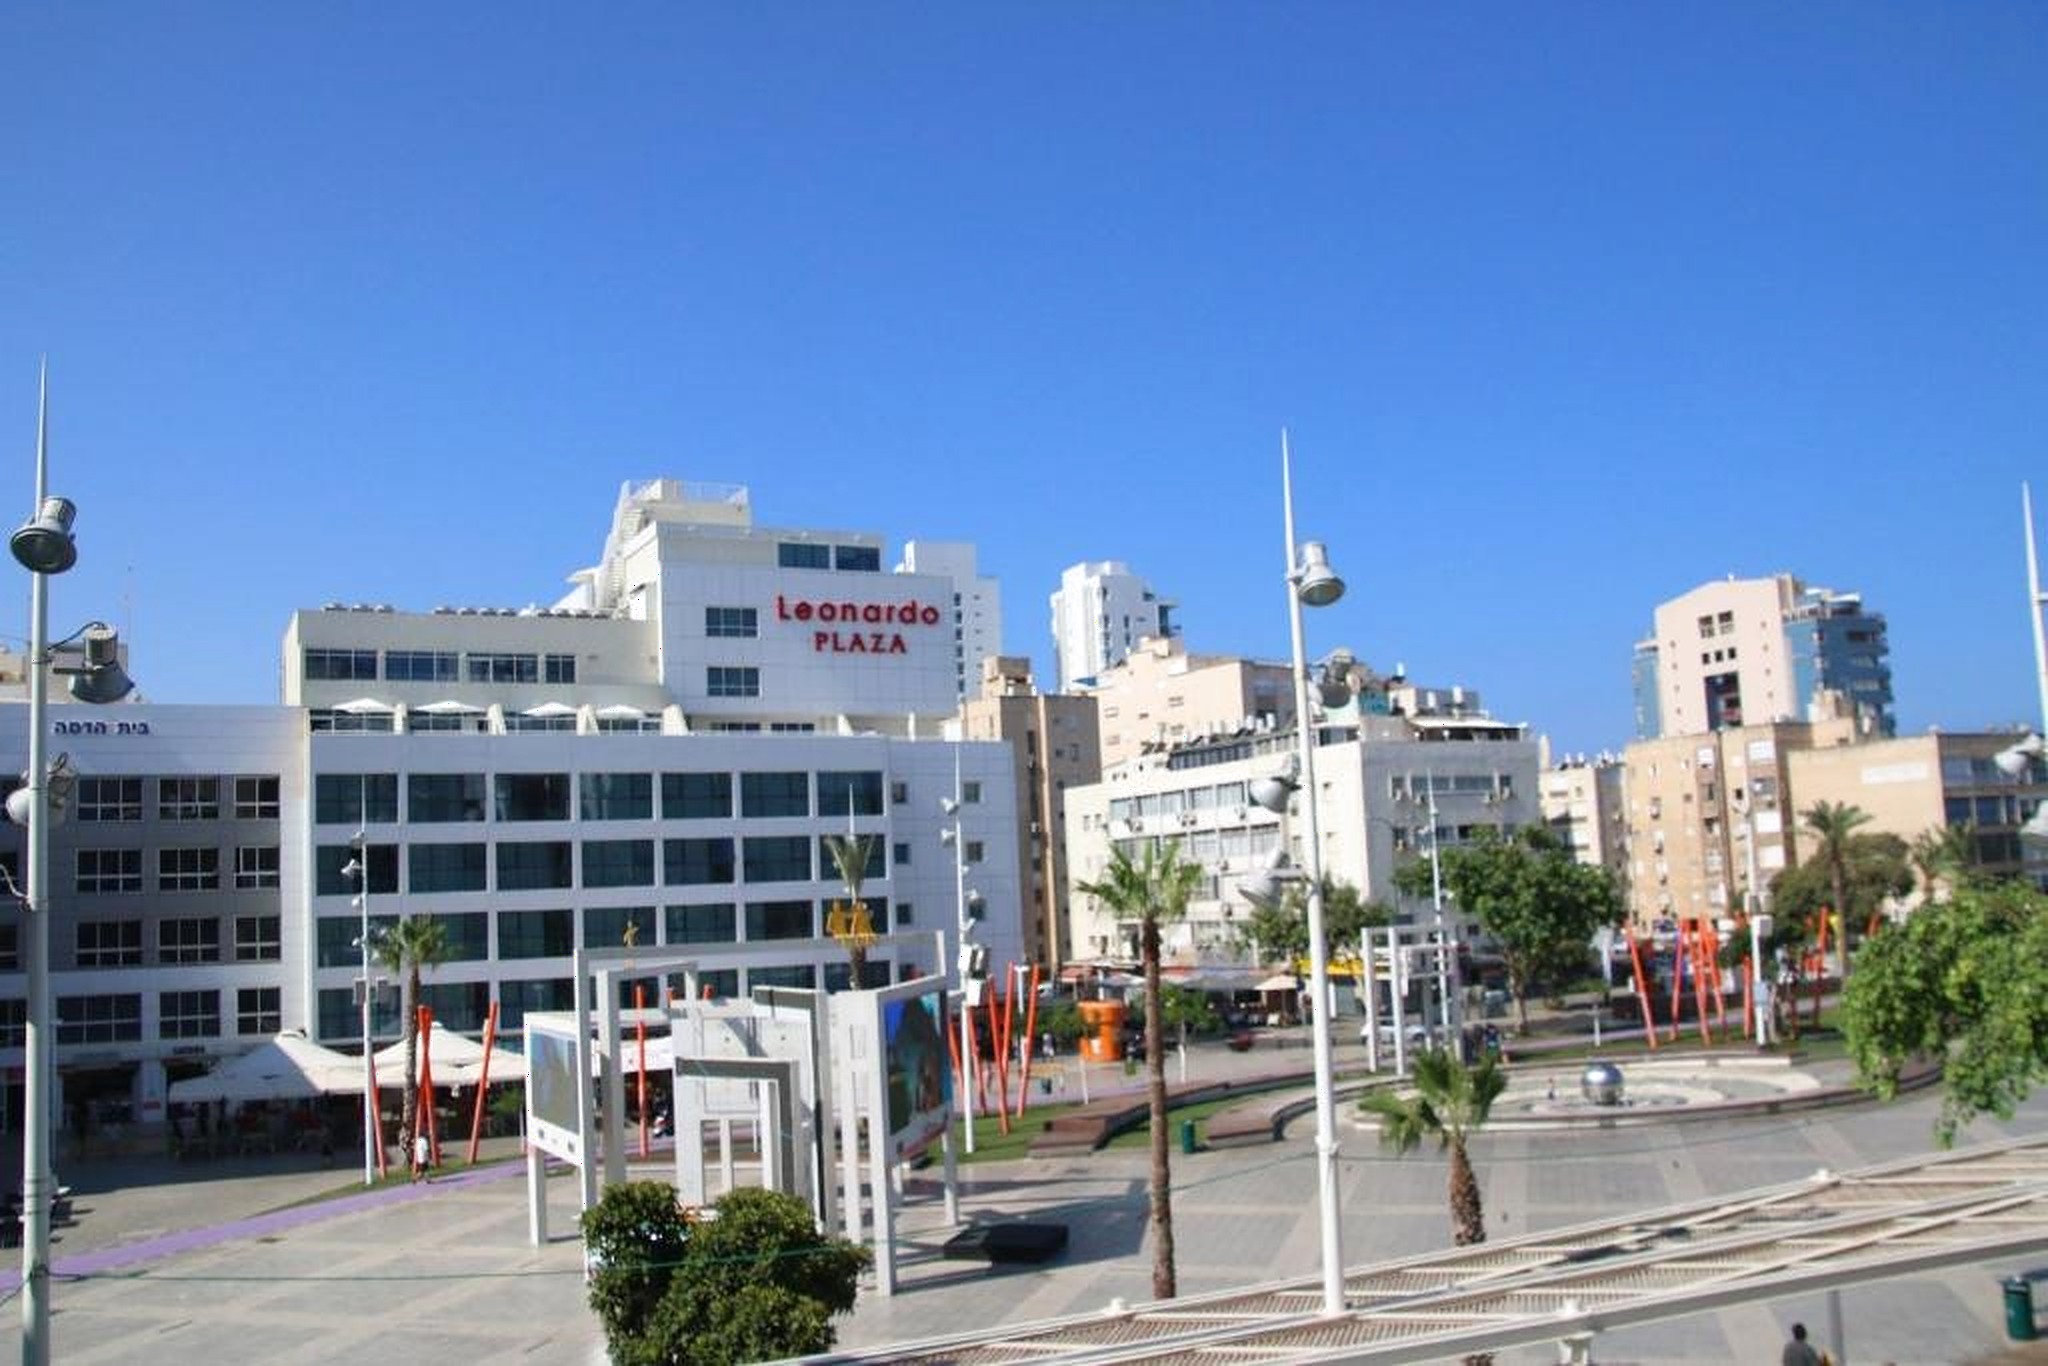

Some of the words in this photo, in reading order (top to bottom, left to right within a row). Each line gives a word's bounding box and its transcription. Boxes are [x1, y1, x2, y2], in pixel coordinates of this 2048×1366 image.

[777, 594, 940, 625] Leonardo
[814, 631, 907, 655] PLAZA
[54, 721, 107, 735] הדסה
[117, 721, 149, 735] בית
